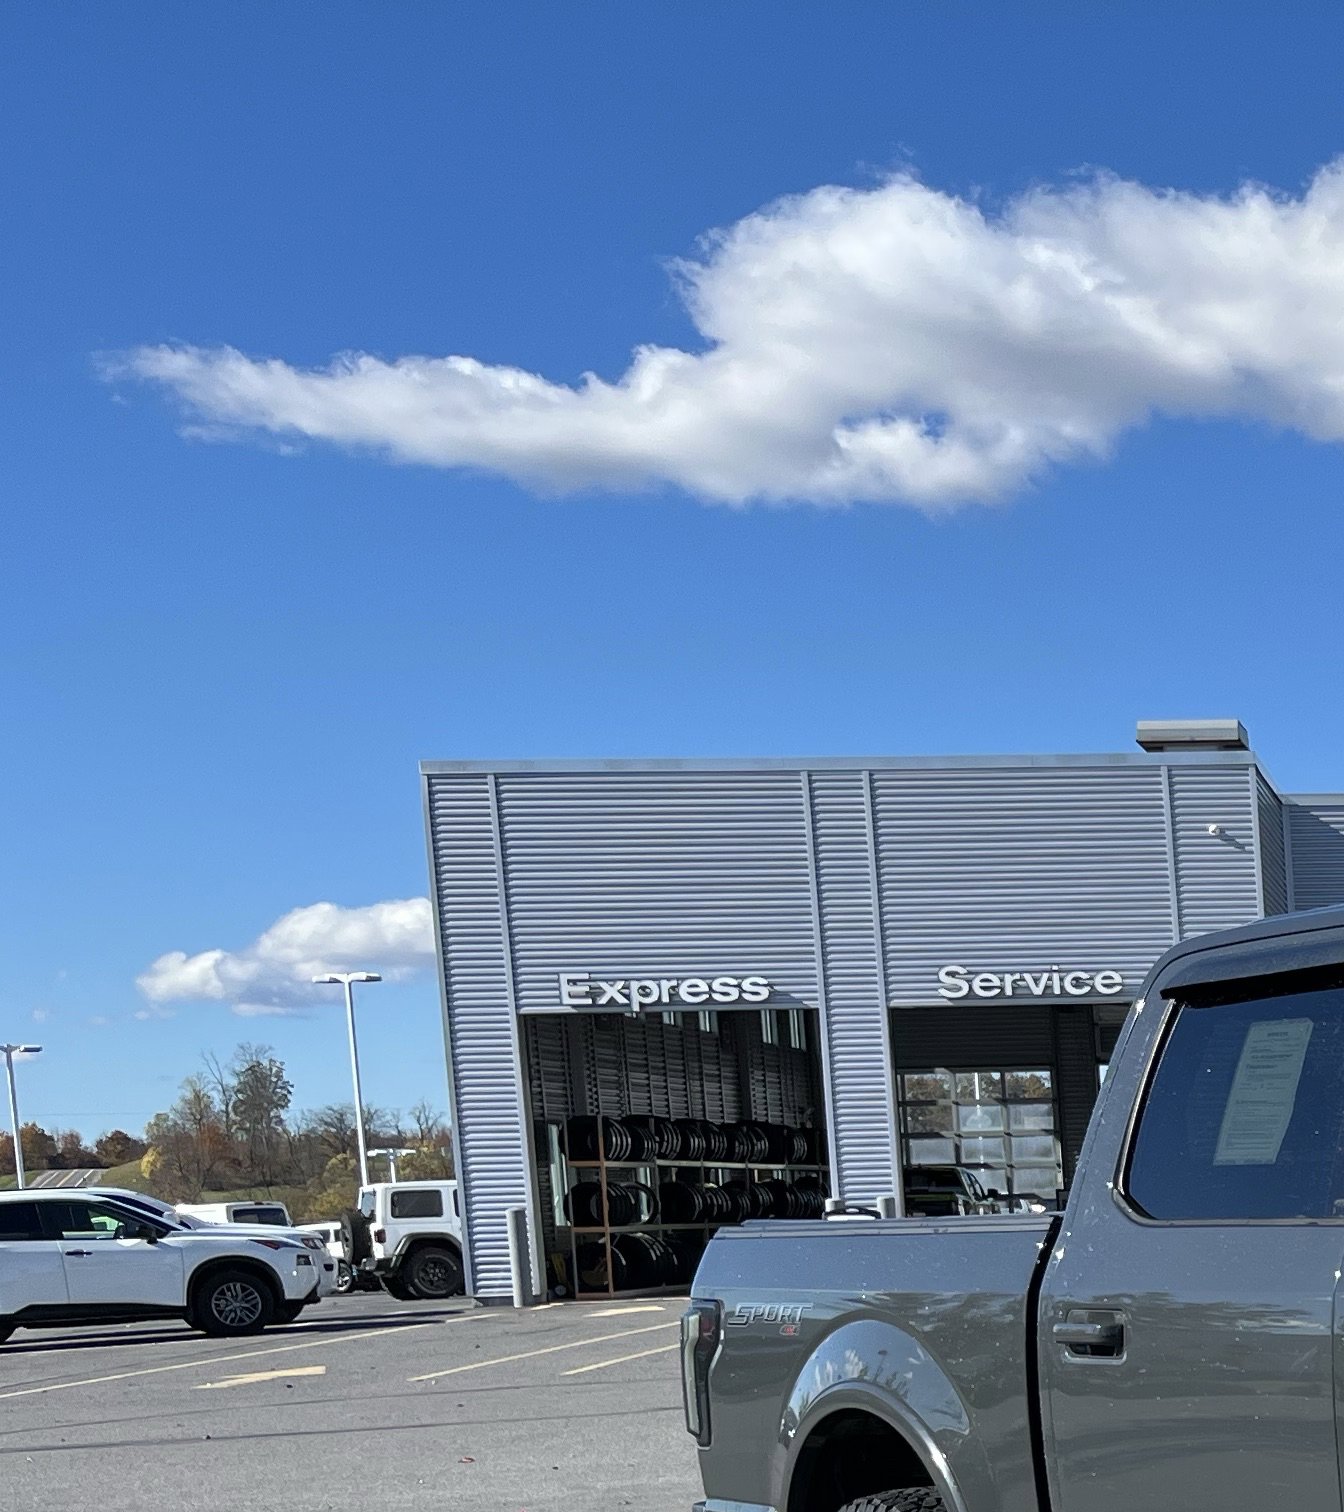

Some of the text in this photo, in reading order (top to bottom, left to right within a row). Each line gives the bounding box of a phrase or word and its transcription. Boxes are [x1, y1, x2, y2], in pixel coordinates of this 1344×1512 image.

[559, 973, 771, 1012] Express
[937, 965, 1124, 999] Service
[727, 1302, 814, 1328] SPORT
